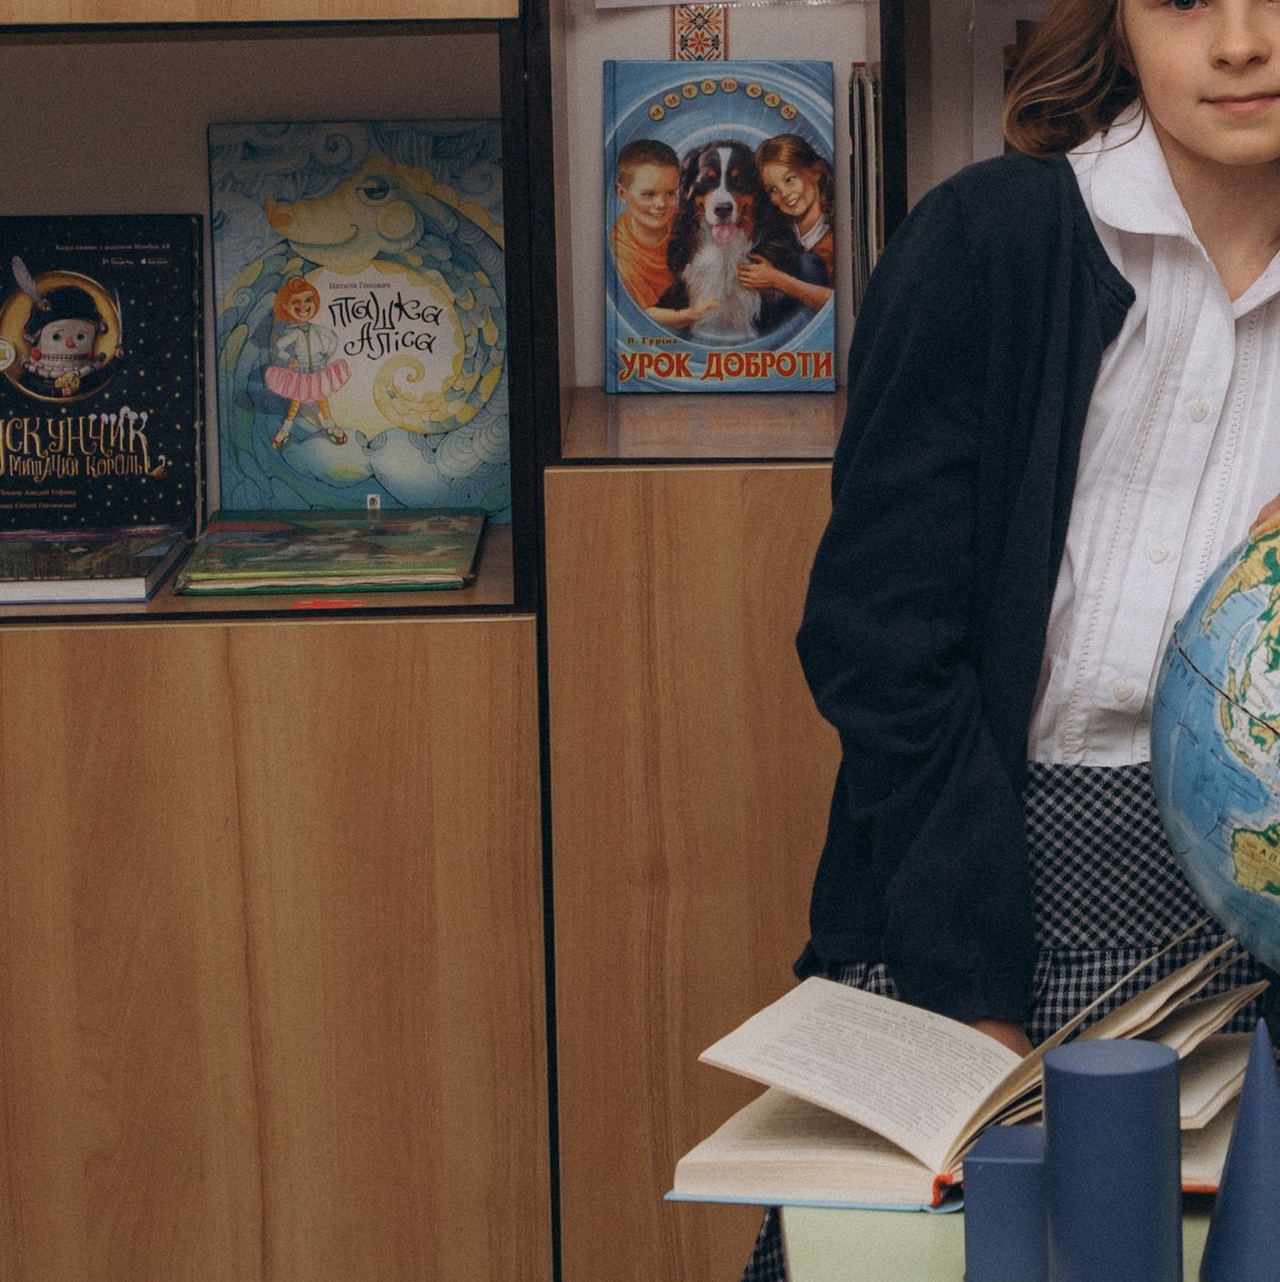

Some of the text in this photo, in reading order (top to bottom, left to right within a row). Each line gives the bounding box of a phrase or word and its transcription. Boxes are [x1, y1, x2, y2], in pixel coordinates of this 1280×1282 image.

[651, 79, 794, 118] ЧИТАЮ САМ
[618, 350, 833, 381] УРОК ДОБРОТИ
